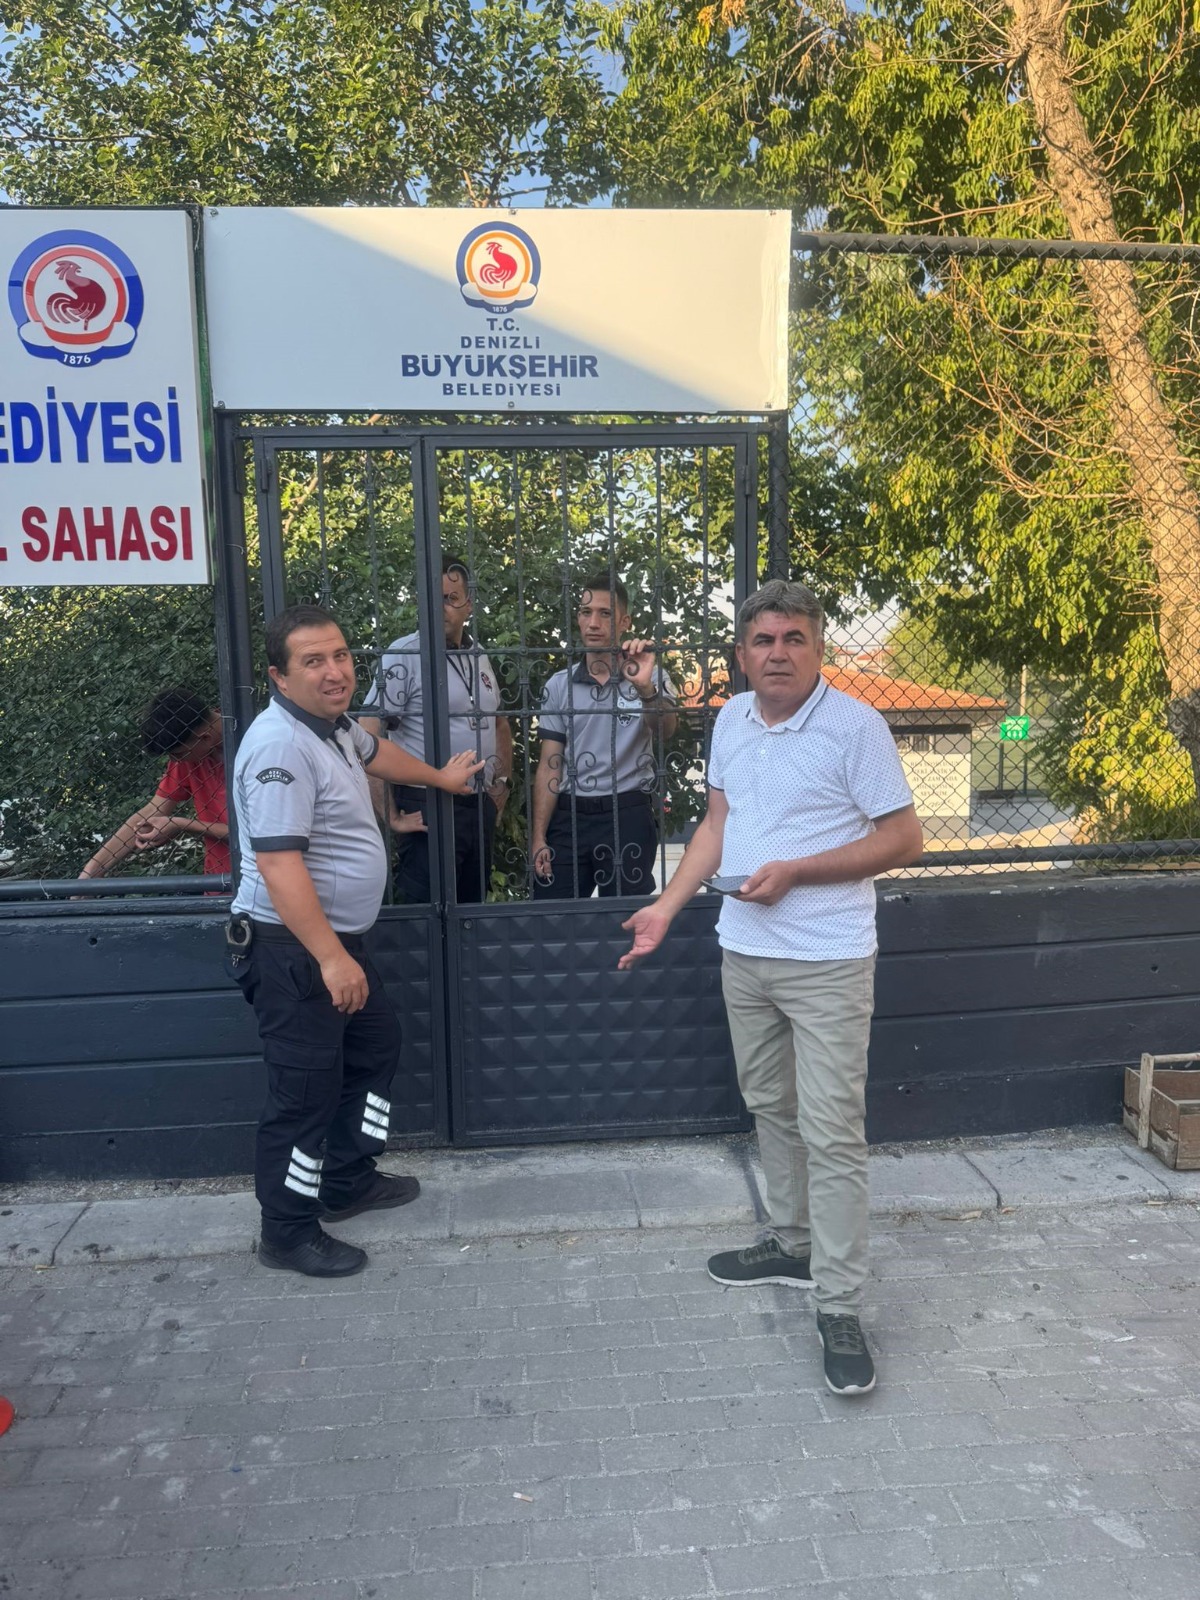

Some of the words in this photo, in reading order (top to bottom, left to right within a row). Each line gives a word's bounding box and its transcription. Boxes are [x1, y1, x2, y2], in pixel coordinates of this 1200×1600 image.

[486, 317, 520, 331] T.C.
[460, 335, 540, 349] DENİZLİ
[63, 354, 91, 364] 1876
[401, 354, 599, 379] BÜYÜKŞEHİR
[442, 383, 561, 396] BELEDİYESİ
[22, 505, 193, 562] SAHASI
